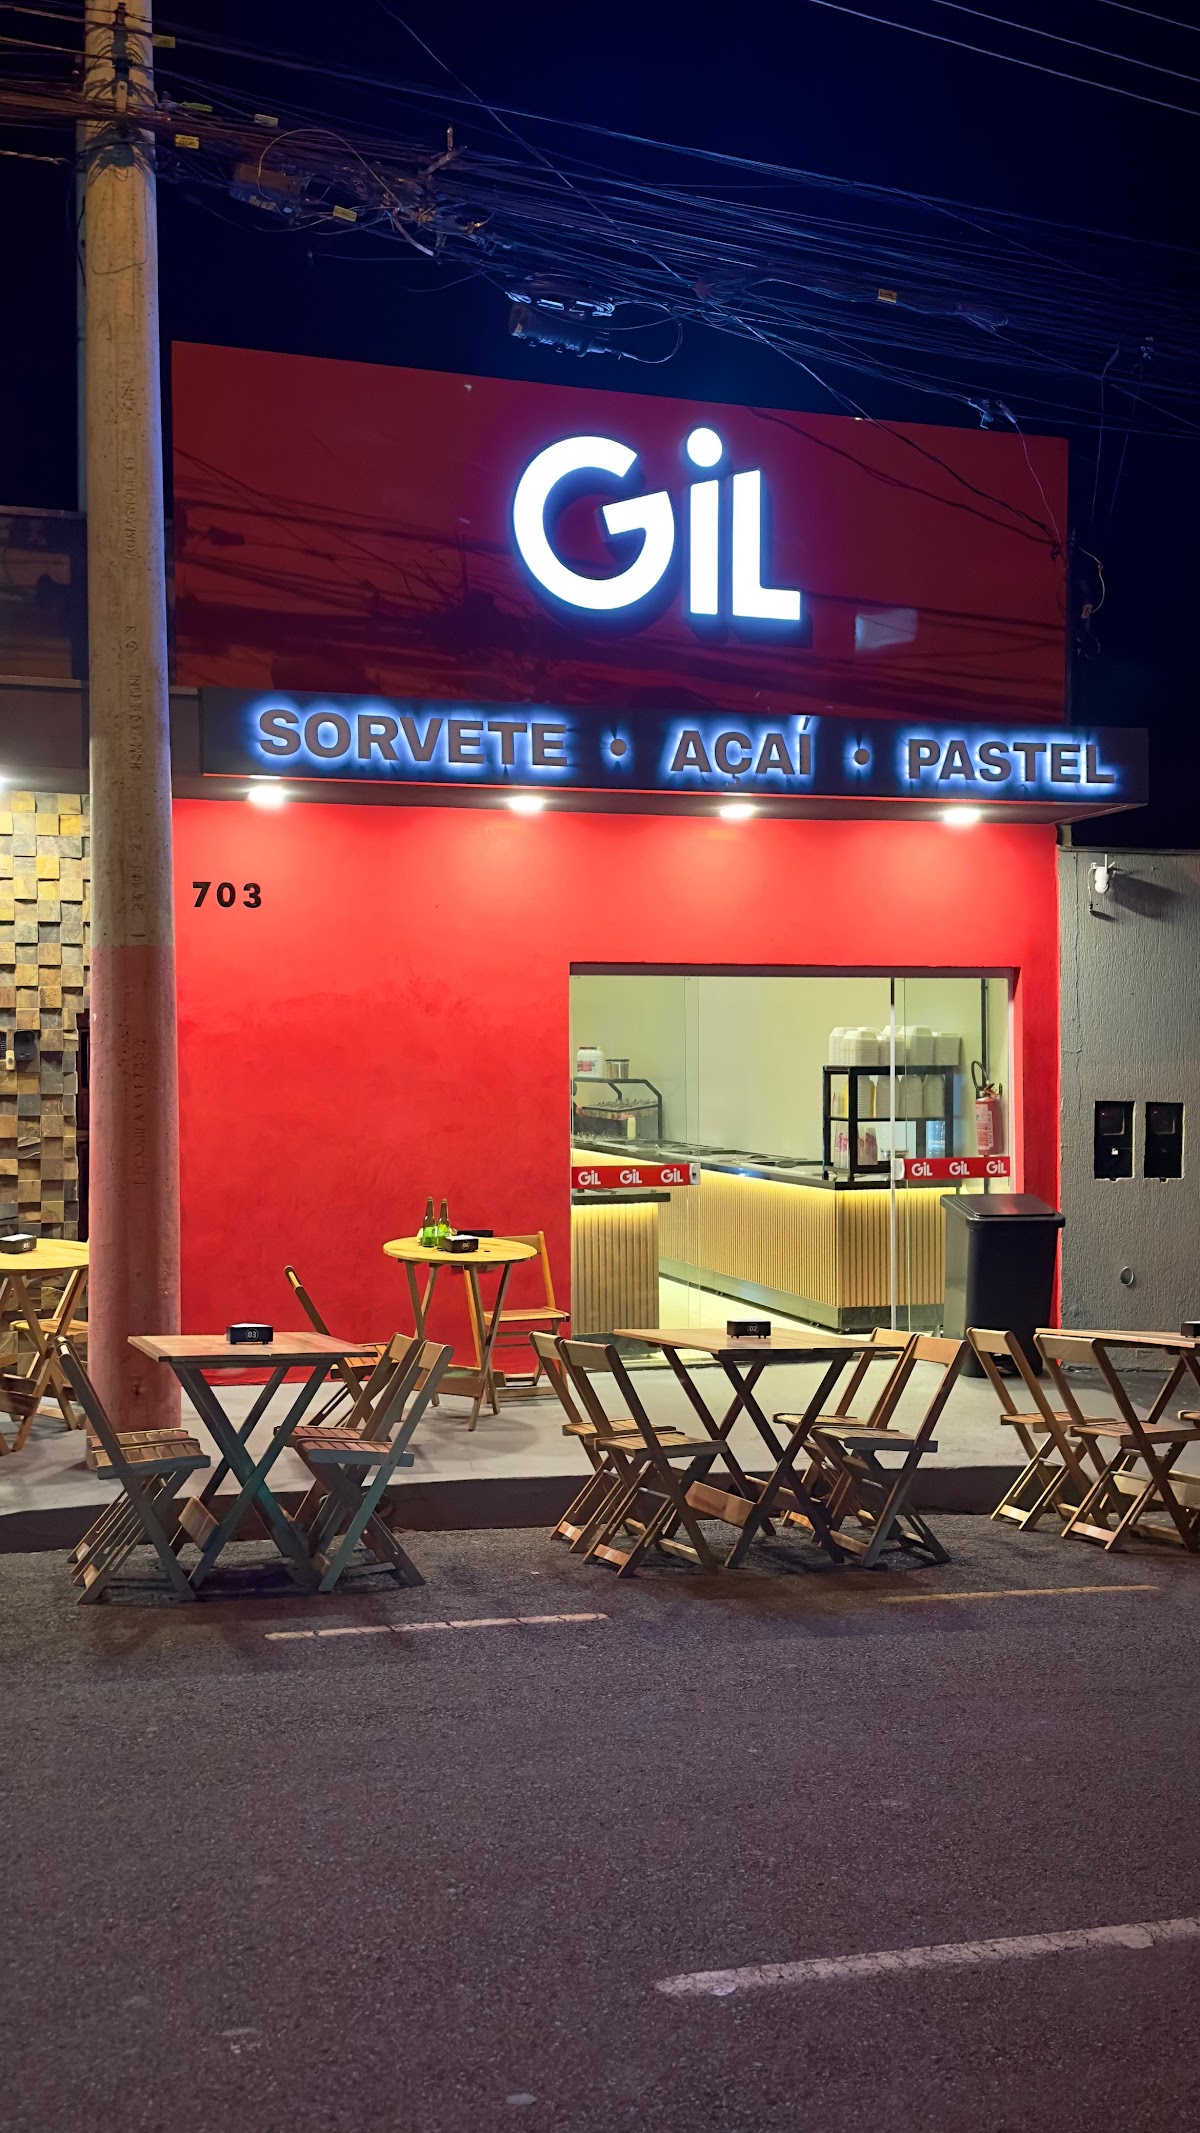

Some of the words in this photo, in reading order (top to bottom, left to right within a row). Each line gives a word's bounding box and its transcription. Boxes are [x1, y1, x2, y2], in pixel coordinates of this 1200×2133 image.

[258, 708, 568, 766] SORVETE
[670, 715, 812, 786] AÇAÍ
[907, 738, 1116, 784] PASTEL
[192, 881, 262, 909] 703
